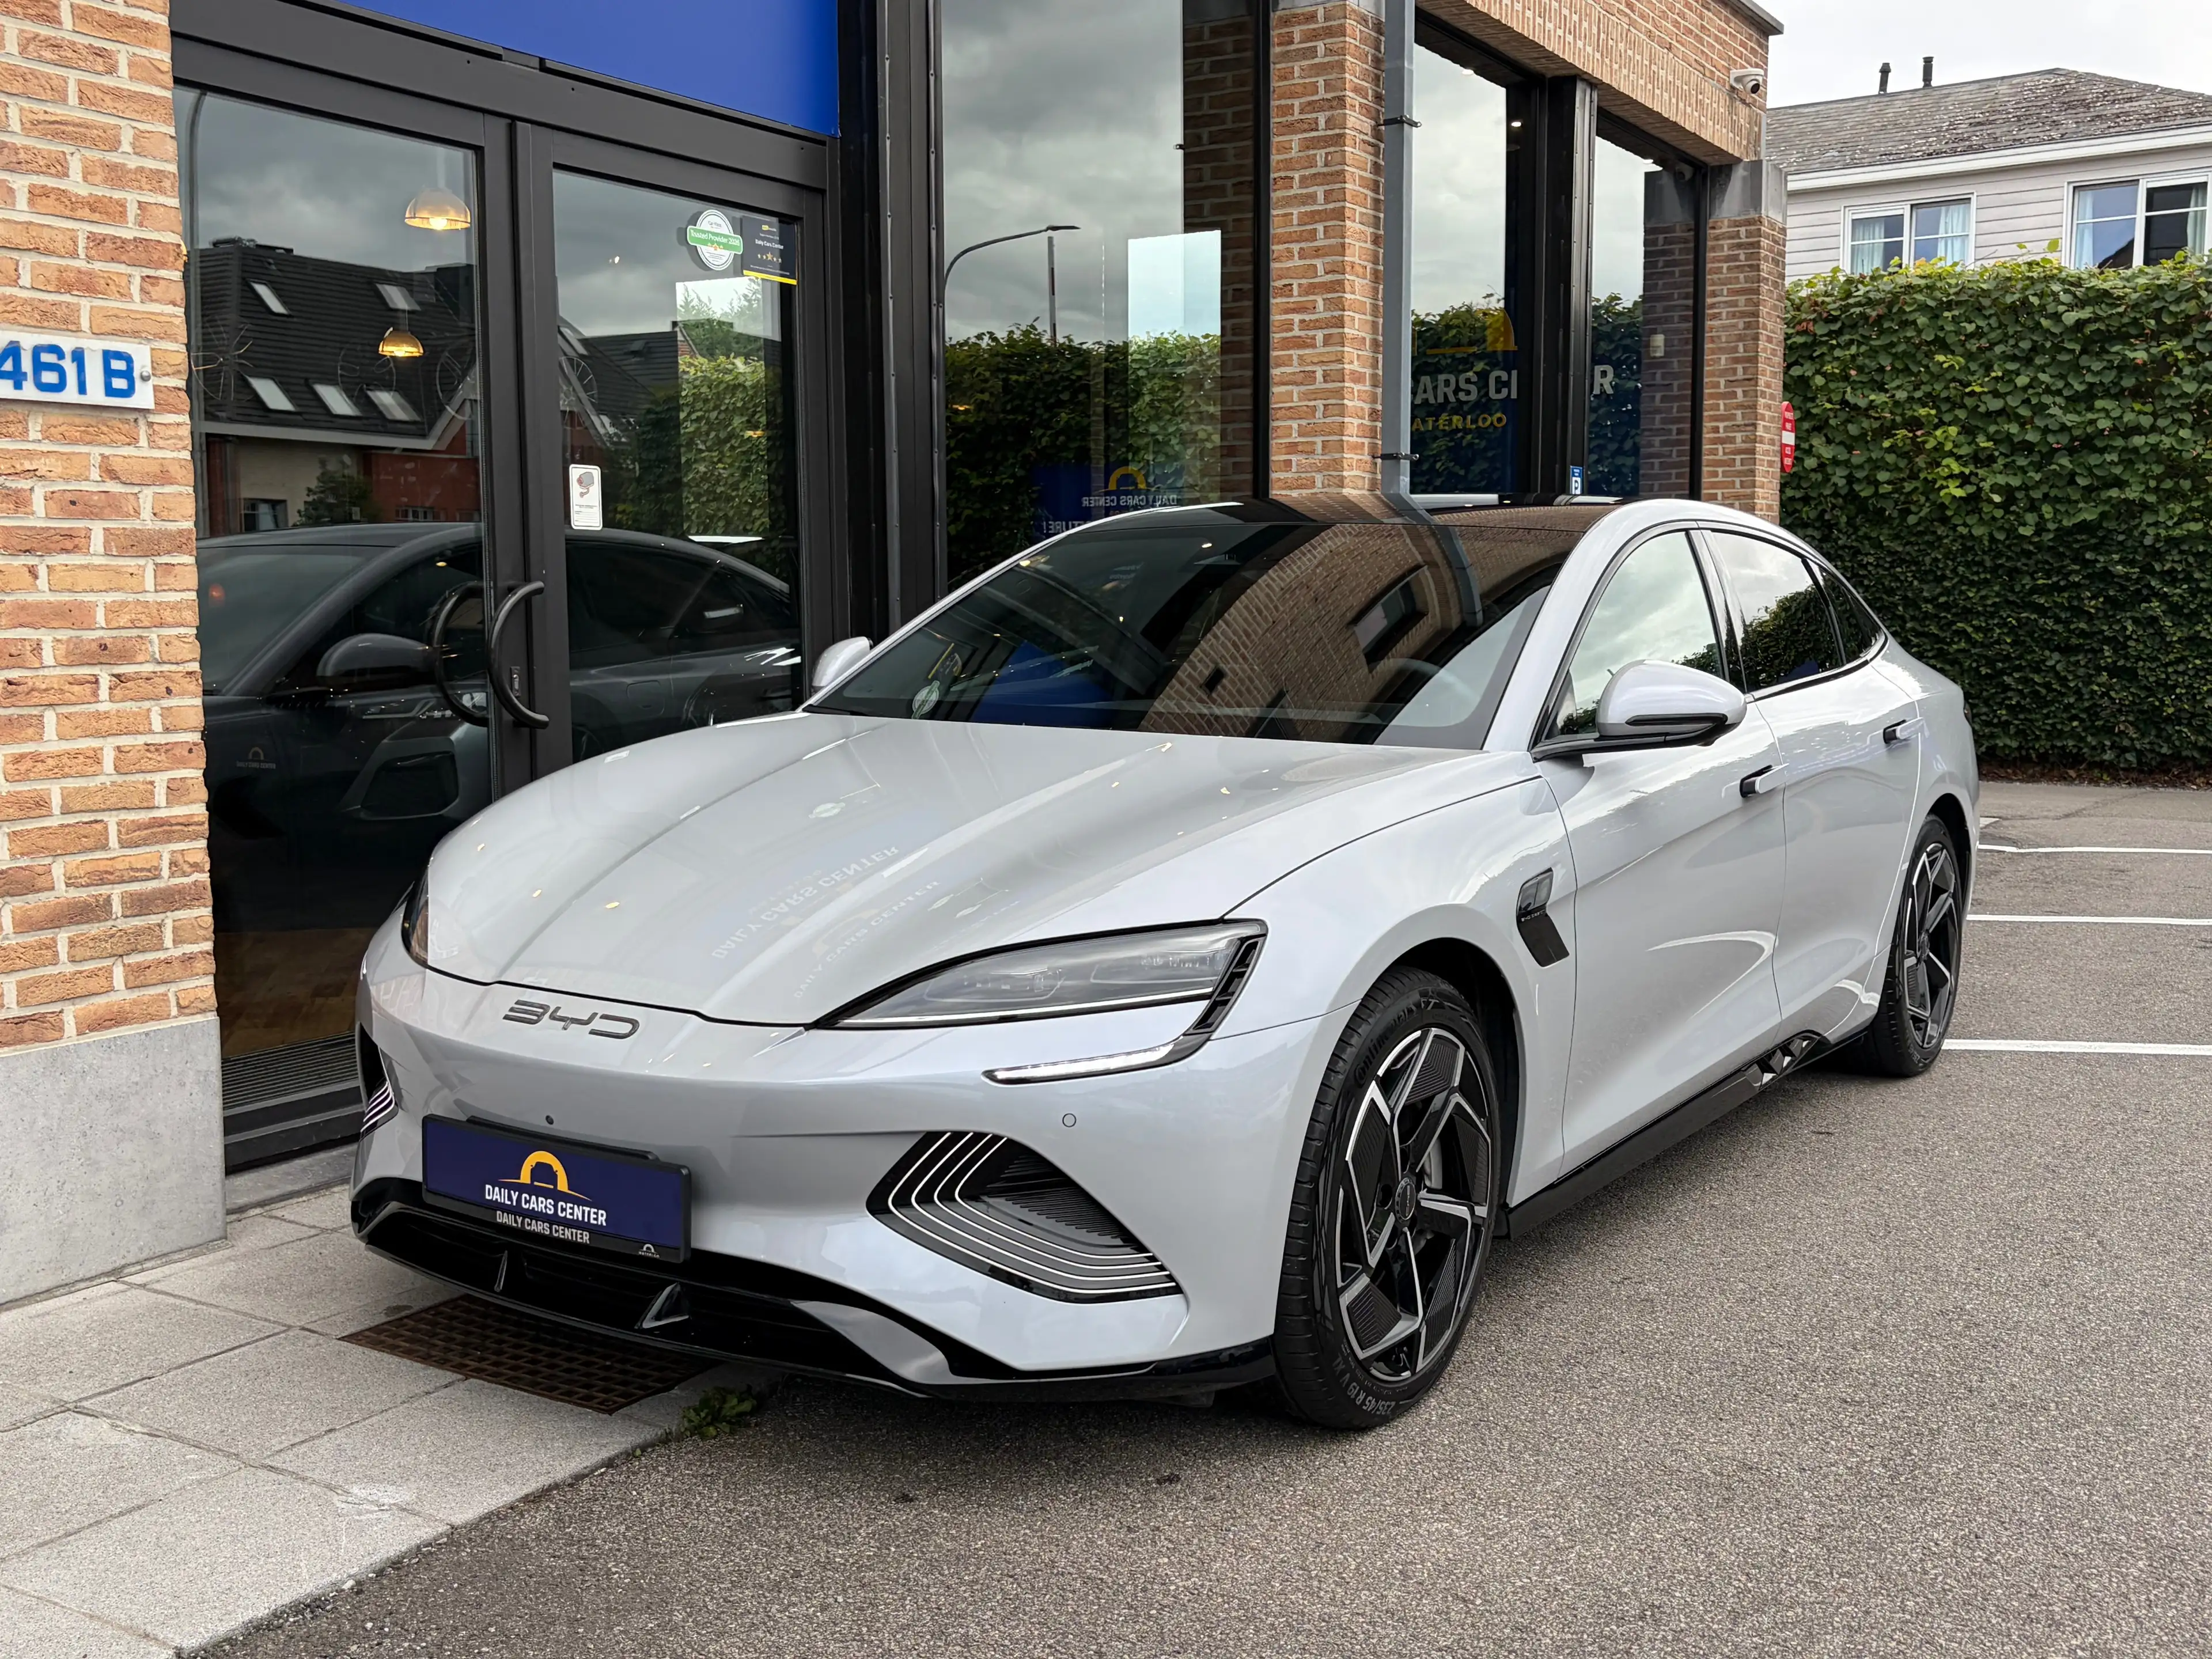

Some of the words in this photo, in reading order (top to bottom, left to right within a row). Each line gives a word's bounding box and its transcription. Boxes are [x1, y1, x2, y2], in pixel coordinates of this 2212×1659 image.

[709, 233, 728, 243] Provider
[1411, 373, 1478, 404] ARS
[1412, 413, 1507, 431] ATERLOO
[502, 999, 640, 1039] BYD
[485, 1184, 518, 1206] DAILY
[521, 1194, 555, 1214] CARS
[558, 1202, 607, 1226] CENTER
[497, 1211, 522, 1228] DAILY
[525, 1219, 550, 1234] CARS
[552, 1225, 590, 1244] CENTER
